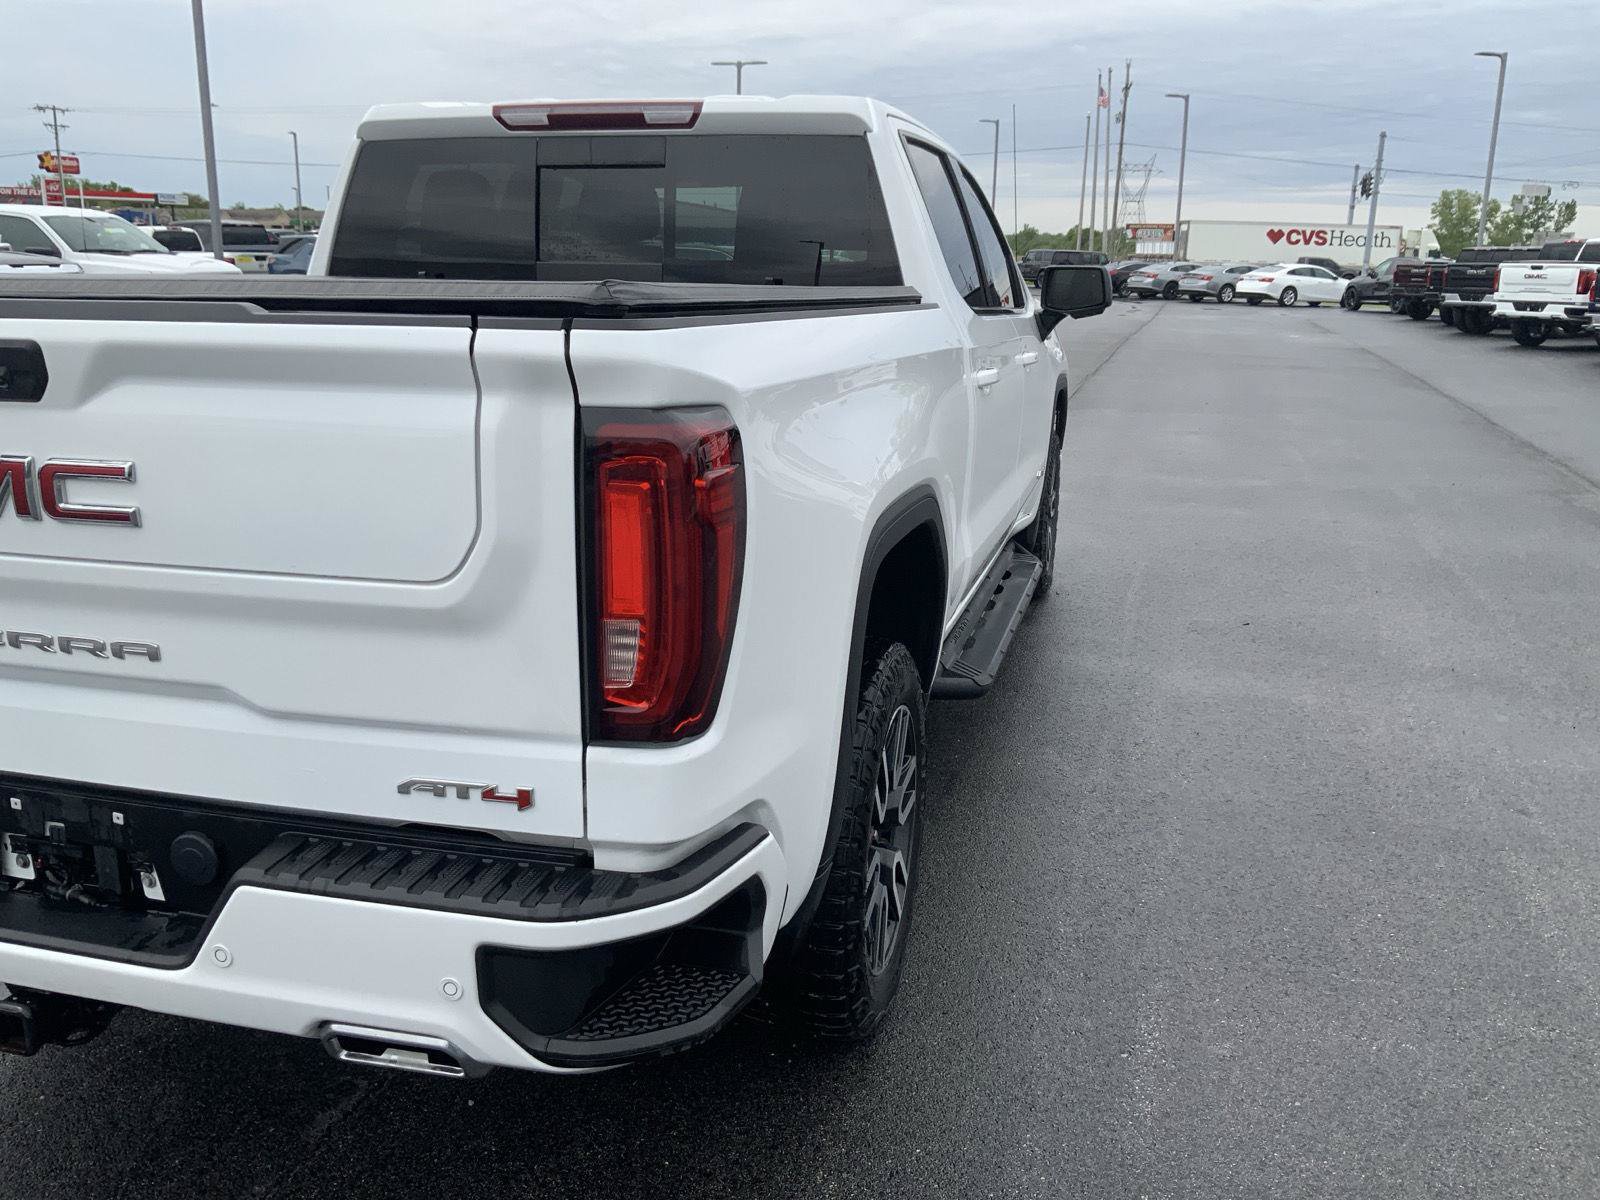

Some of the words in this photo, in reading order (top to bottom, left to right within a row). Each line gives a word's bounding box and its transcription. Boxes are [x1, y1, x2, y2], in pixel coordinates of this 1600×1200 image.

[13, 188, 29, 196] THE
[29, 188, 42, 196] FLY
[1286, 228, 1328, 246] CVS
[1328, 229, 1393, 249] Heath
[0, 629, 162, 663] RRA
[397, 776, 536, 812] AT4
